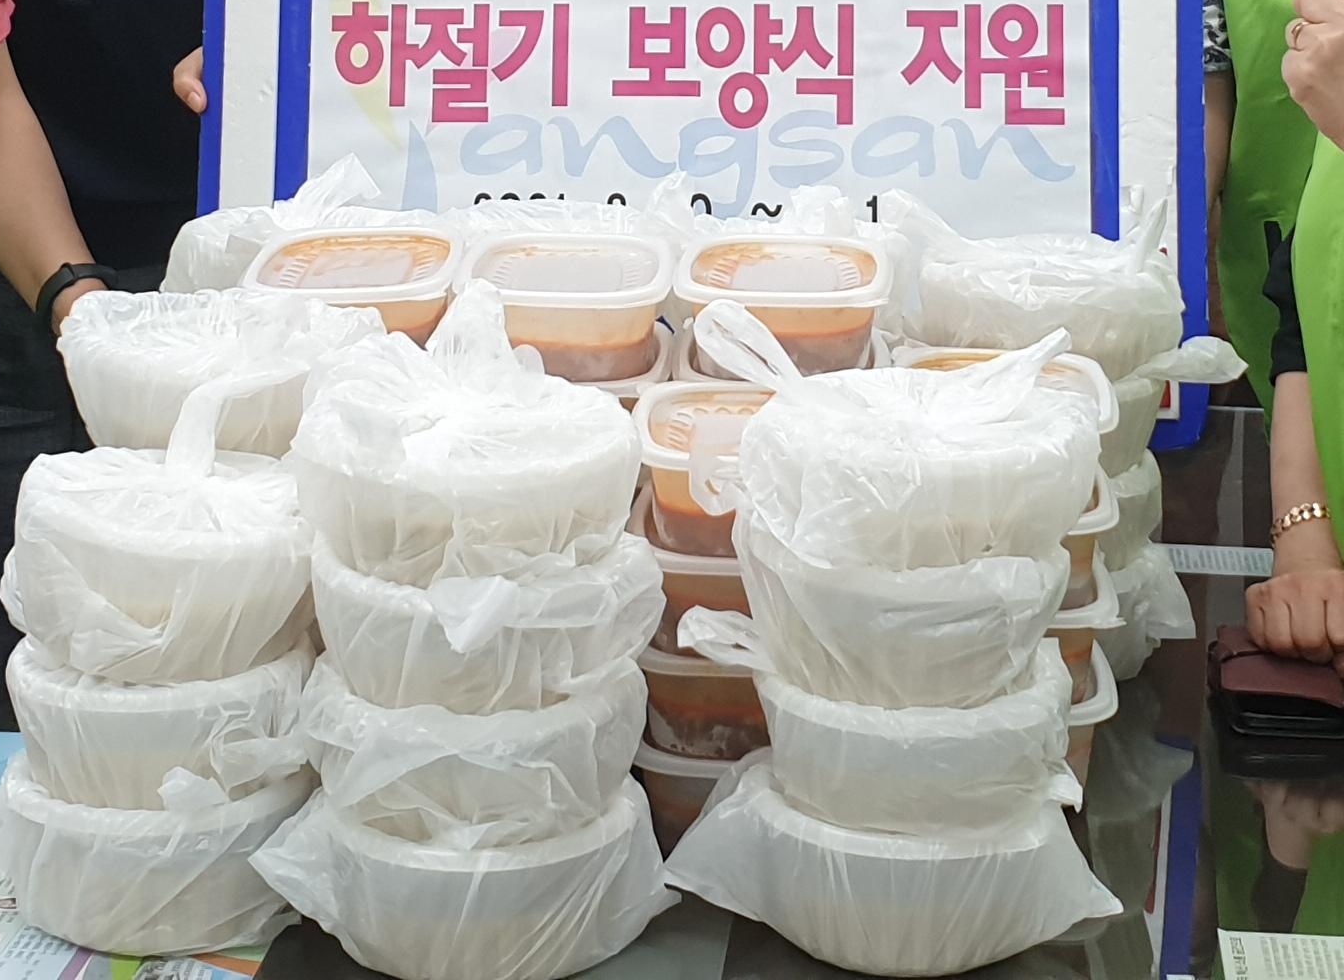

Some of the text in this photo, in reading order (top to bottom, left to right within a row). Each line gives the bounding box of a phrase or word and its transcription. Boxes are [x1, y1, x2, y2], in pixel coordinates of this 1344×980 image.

[331, 1, 1066, 130] 하절기 보양식 지원
